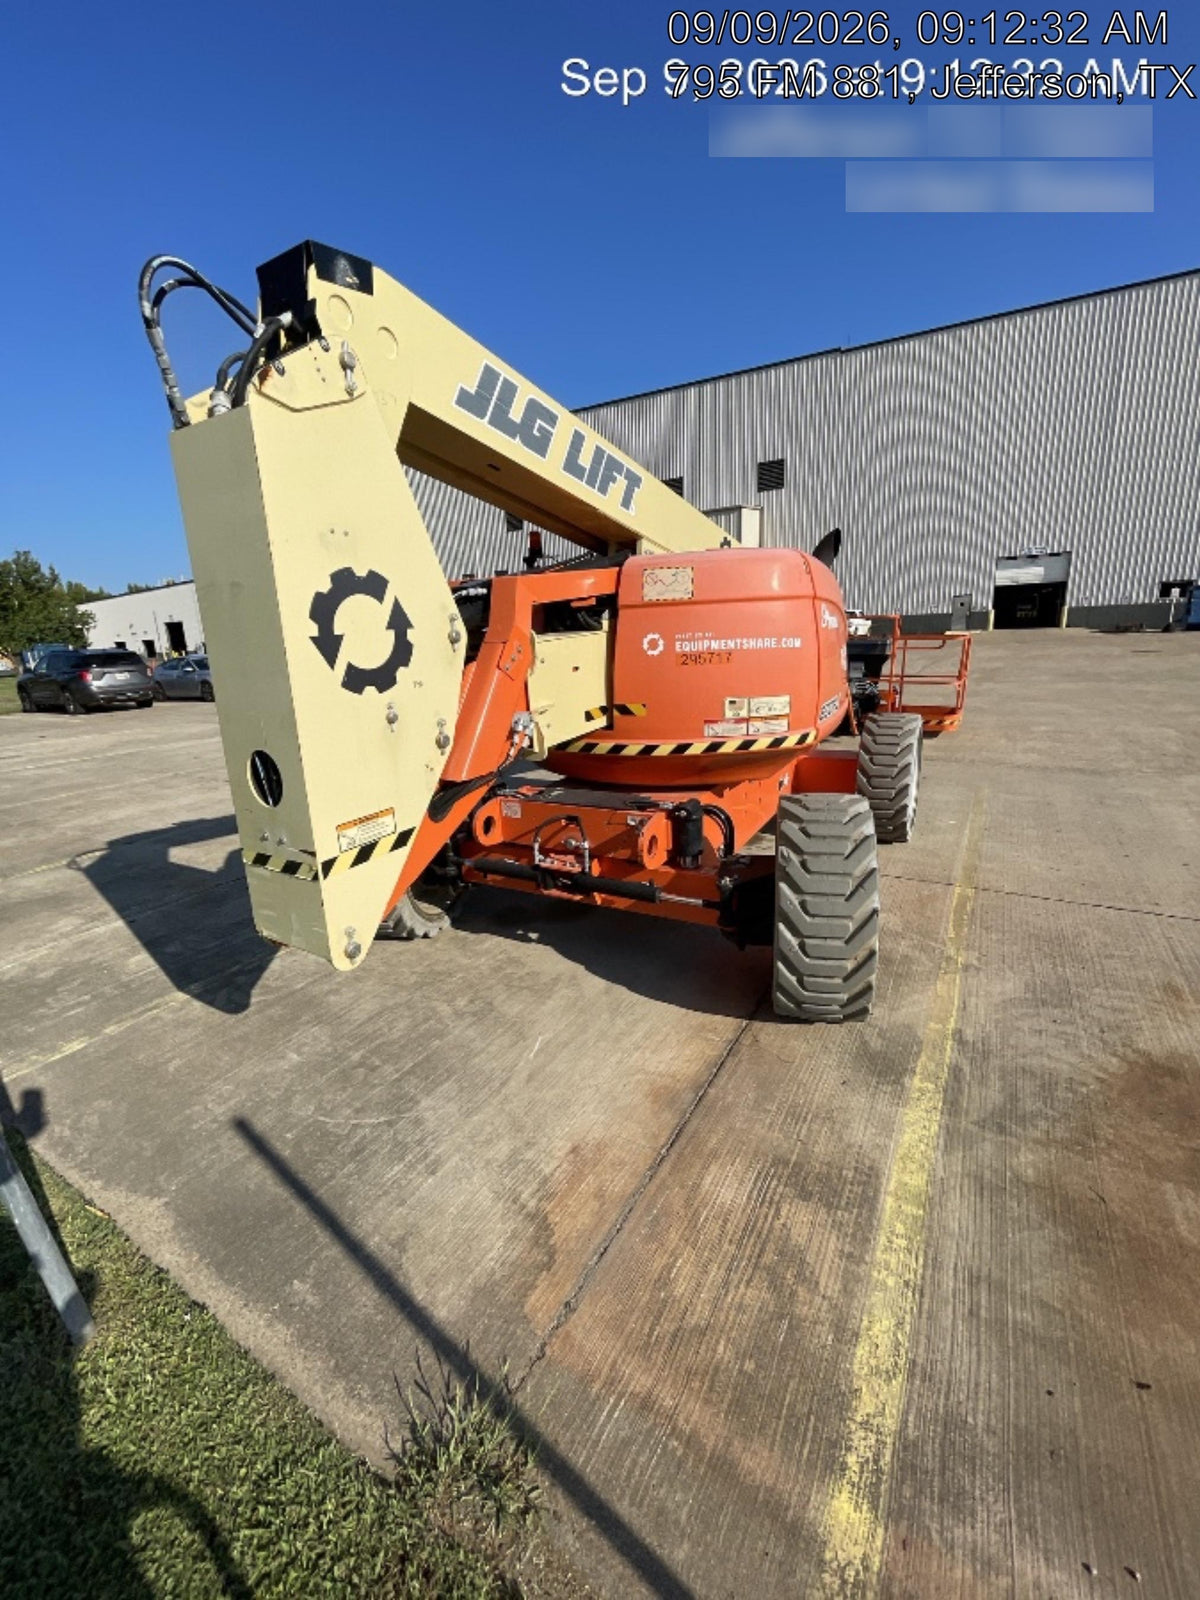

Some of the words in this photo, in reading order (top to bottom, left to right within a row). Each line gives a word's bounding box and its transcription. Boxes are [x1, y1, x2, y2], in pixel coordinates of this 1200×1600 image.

[452, 359, 561, 461] JLG
[560, 426, 644, 516] LIFT
[674, 637, 803, 653] EQUIPMENTSHARE.COM
